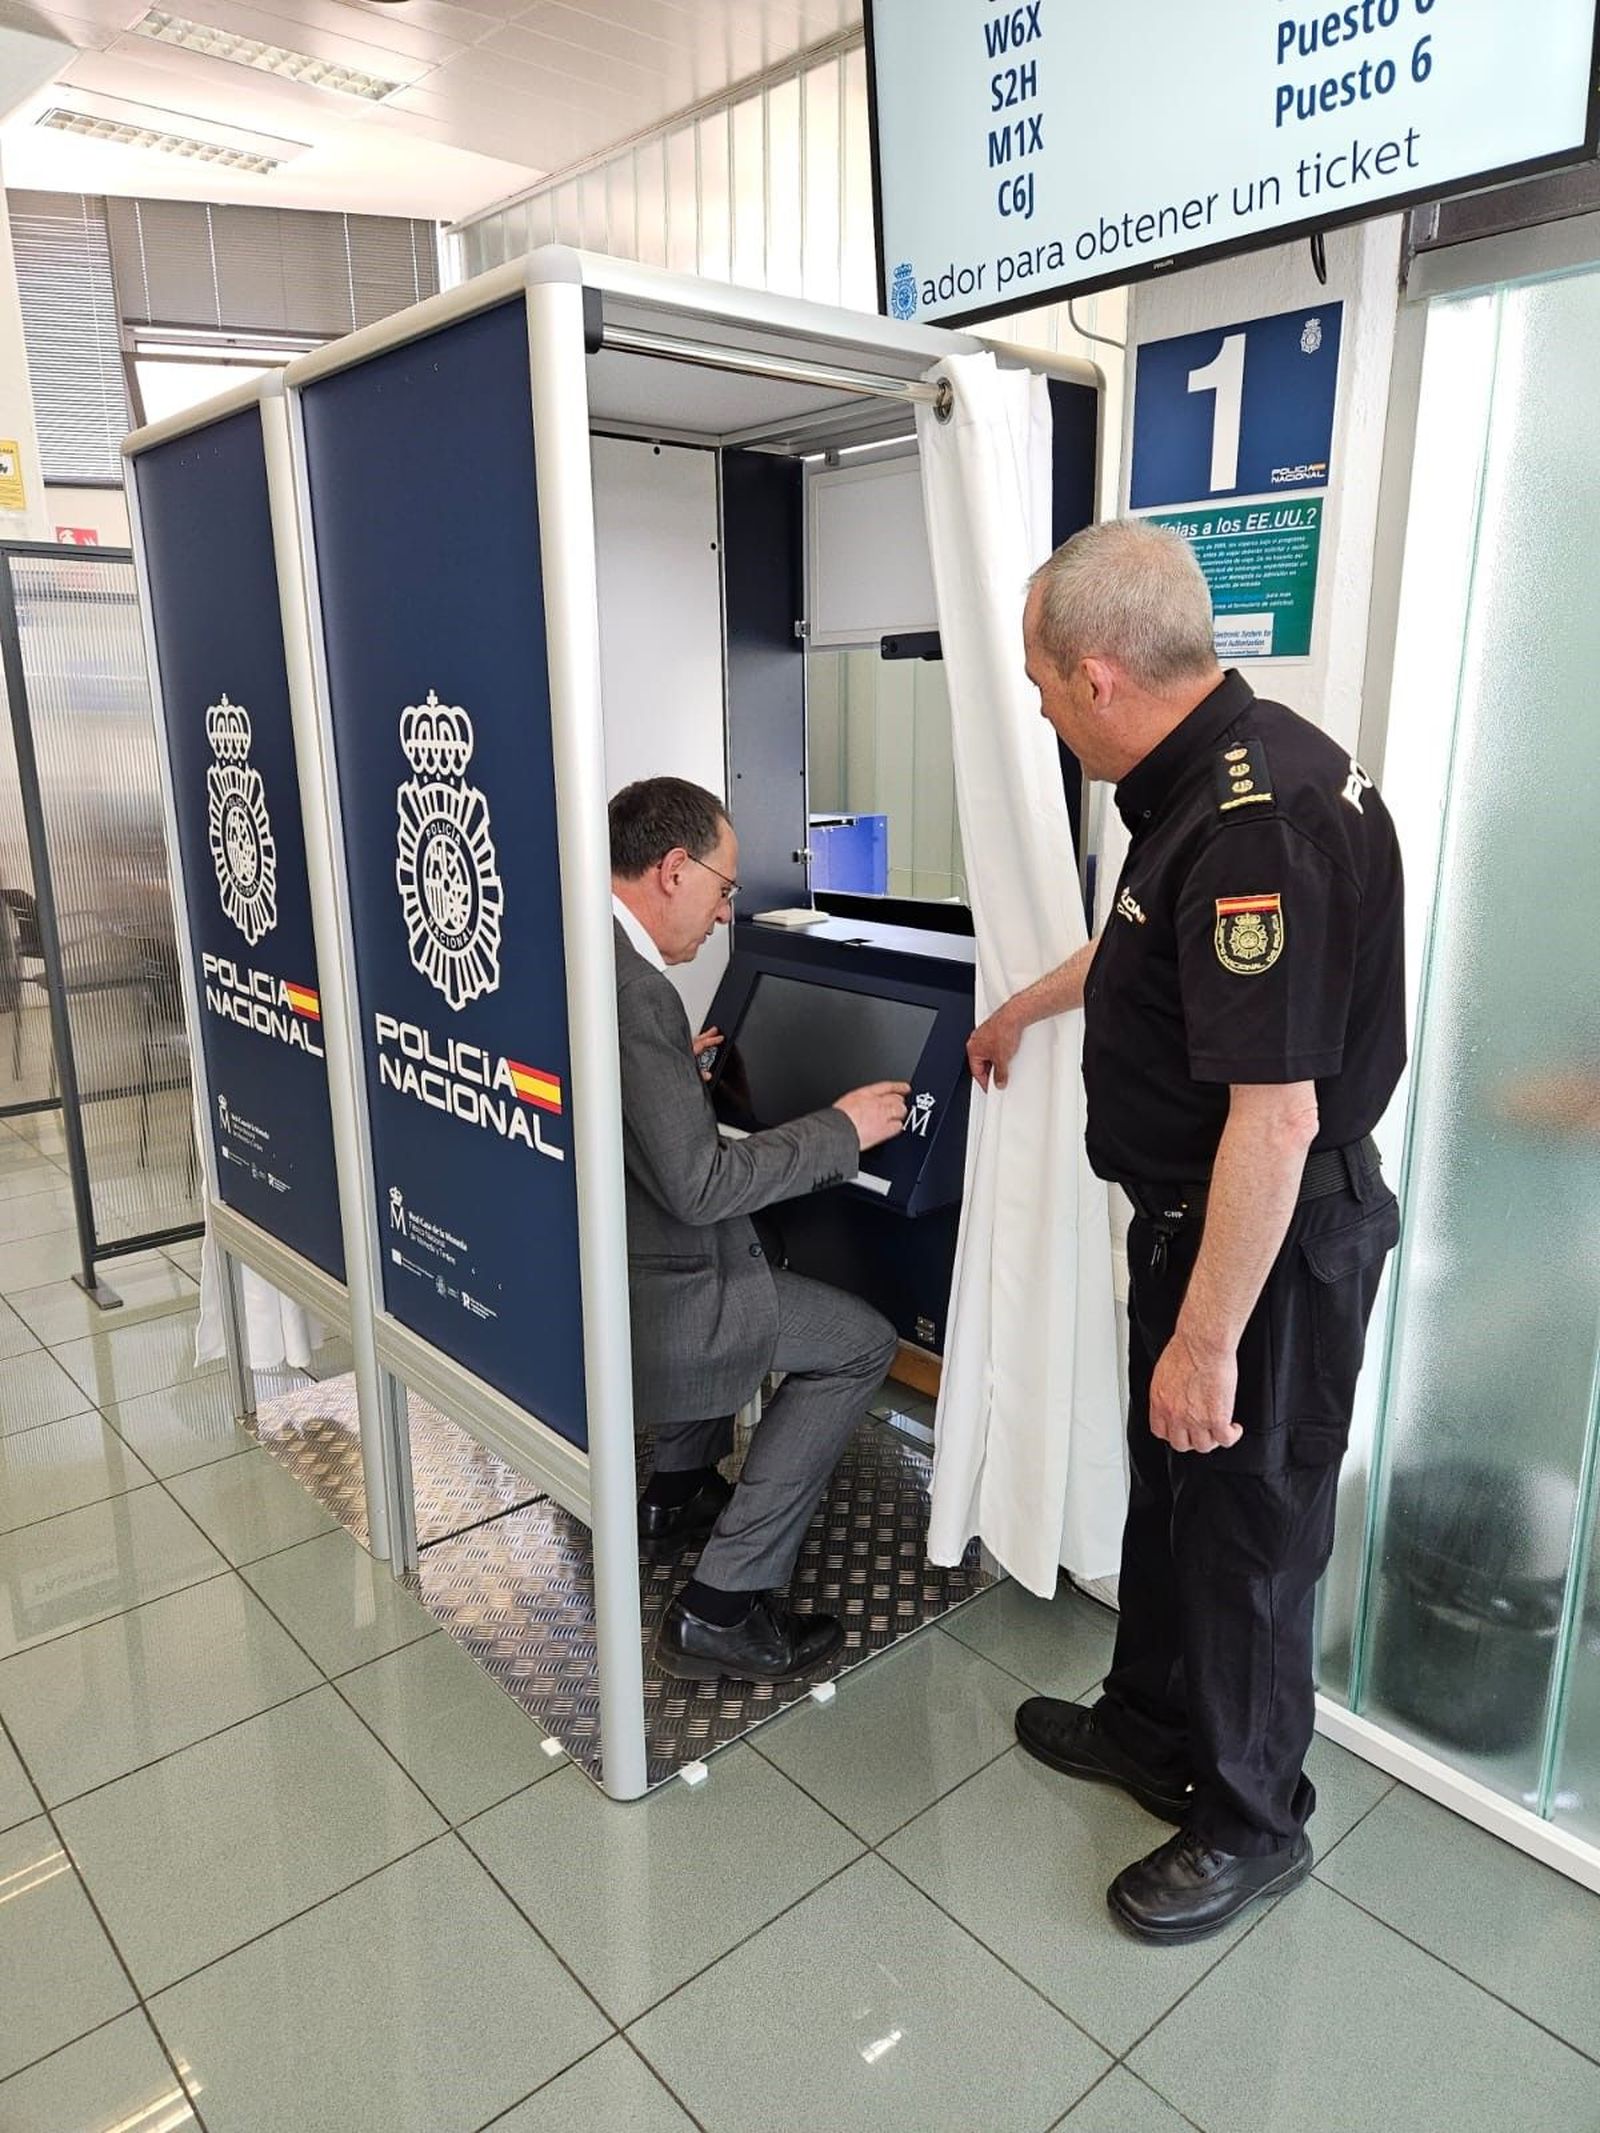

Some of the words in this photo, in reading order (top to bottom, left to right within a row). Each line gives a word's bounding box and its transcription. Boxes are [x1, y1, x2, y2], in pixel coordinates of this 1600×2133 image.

[984, 1, 1042, 58] W6X
[1277, 0, 1399, 65] Puesto
[991, 60, 1037, 112] S2H
[1275, 59, 1397, 128] Puesto
[1411, 34, 1432, 83] 6
[988, 113, 1044, 168] M1X
[921, 263, 986, 305] ador
[996, 241, 1065, 292] para
[1076, 193, 1218, 260] obtener
[1233, 176, 1279, 215] un
[1296, 127, 1421, 198] ticket
[998, 172, 1034, 220] C6J
[1187, 332, 1246, 492] 1
[1271, 471, 1326, 484] NACIONAL
[1202, 521, 1212, 535] a
[1216, 516, 1241, 535] los
[1245, 507, 1317, 531] EE.UU.?
[206, 984, 325, 1059] NACIONAL
[379, 1052, 565, 1161] NACIONAL
